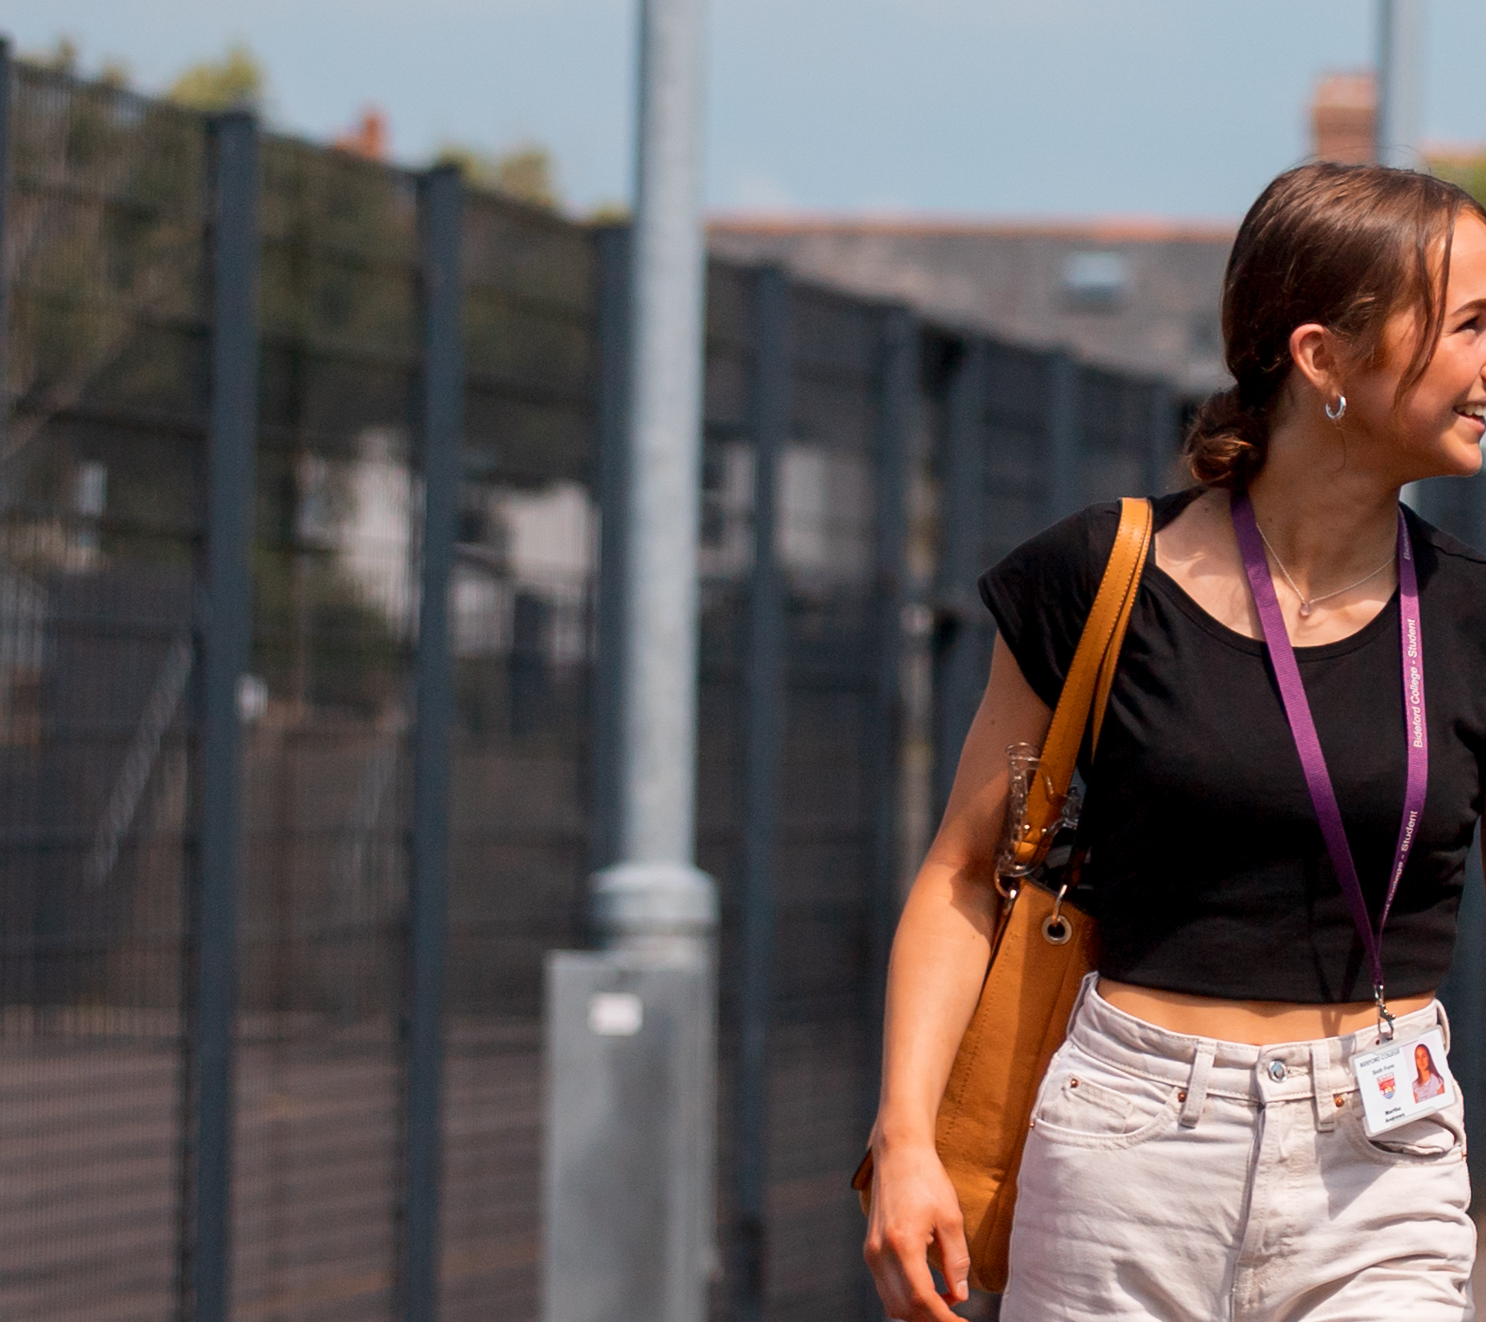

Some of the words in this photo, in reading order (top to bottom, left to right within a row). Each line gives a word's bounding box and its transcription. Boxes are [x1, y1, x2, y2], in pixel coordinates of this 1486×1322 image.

[1407, 619, 1418, 658] Student
[1410, 666, 1421, 704] College
[1412, 706, 1423, 748] Bideford
[1401, 810, 1418, 852] Student
